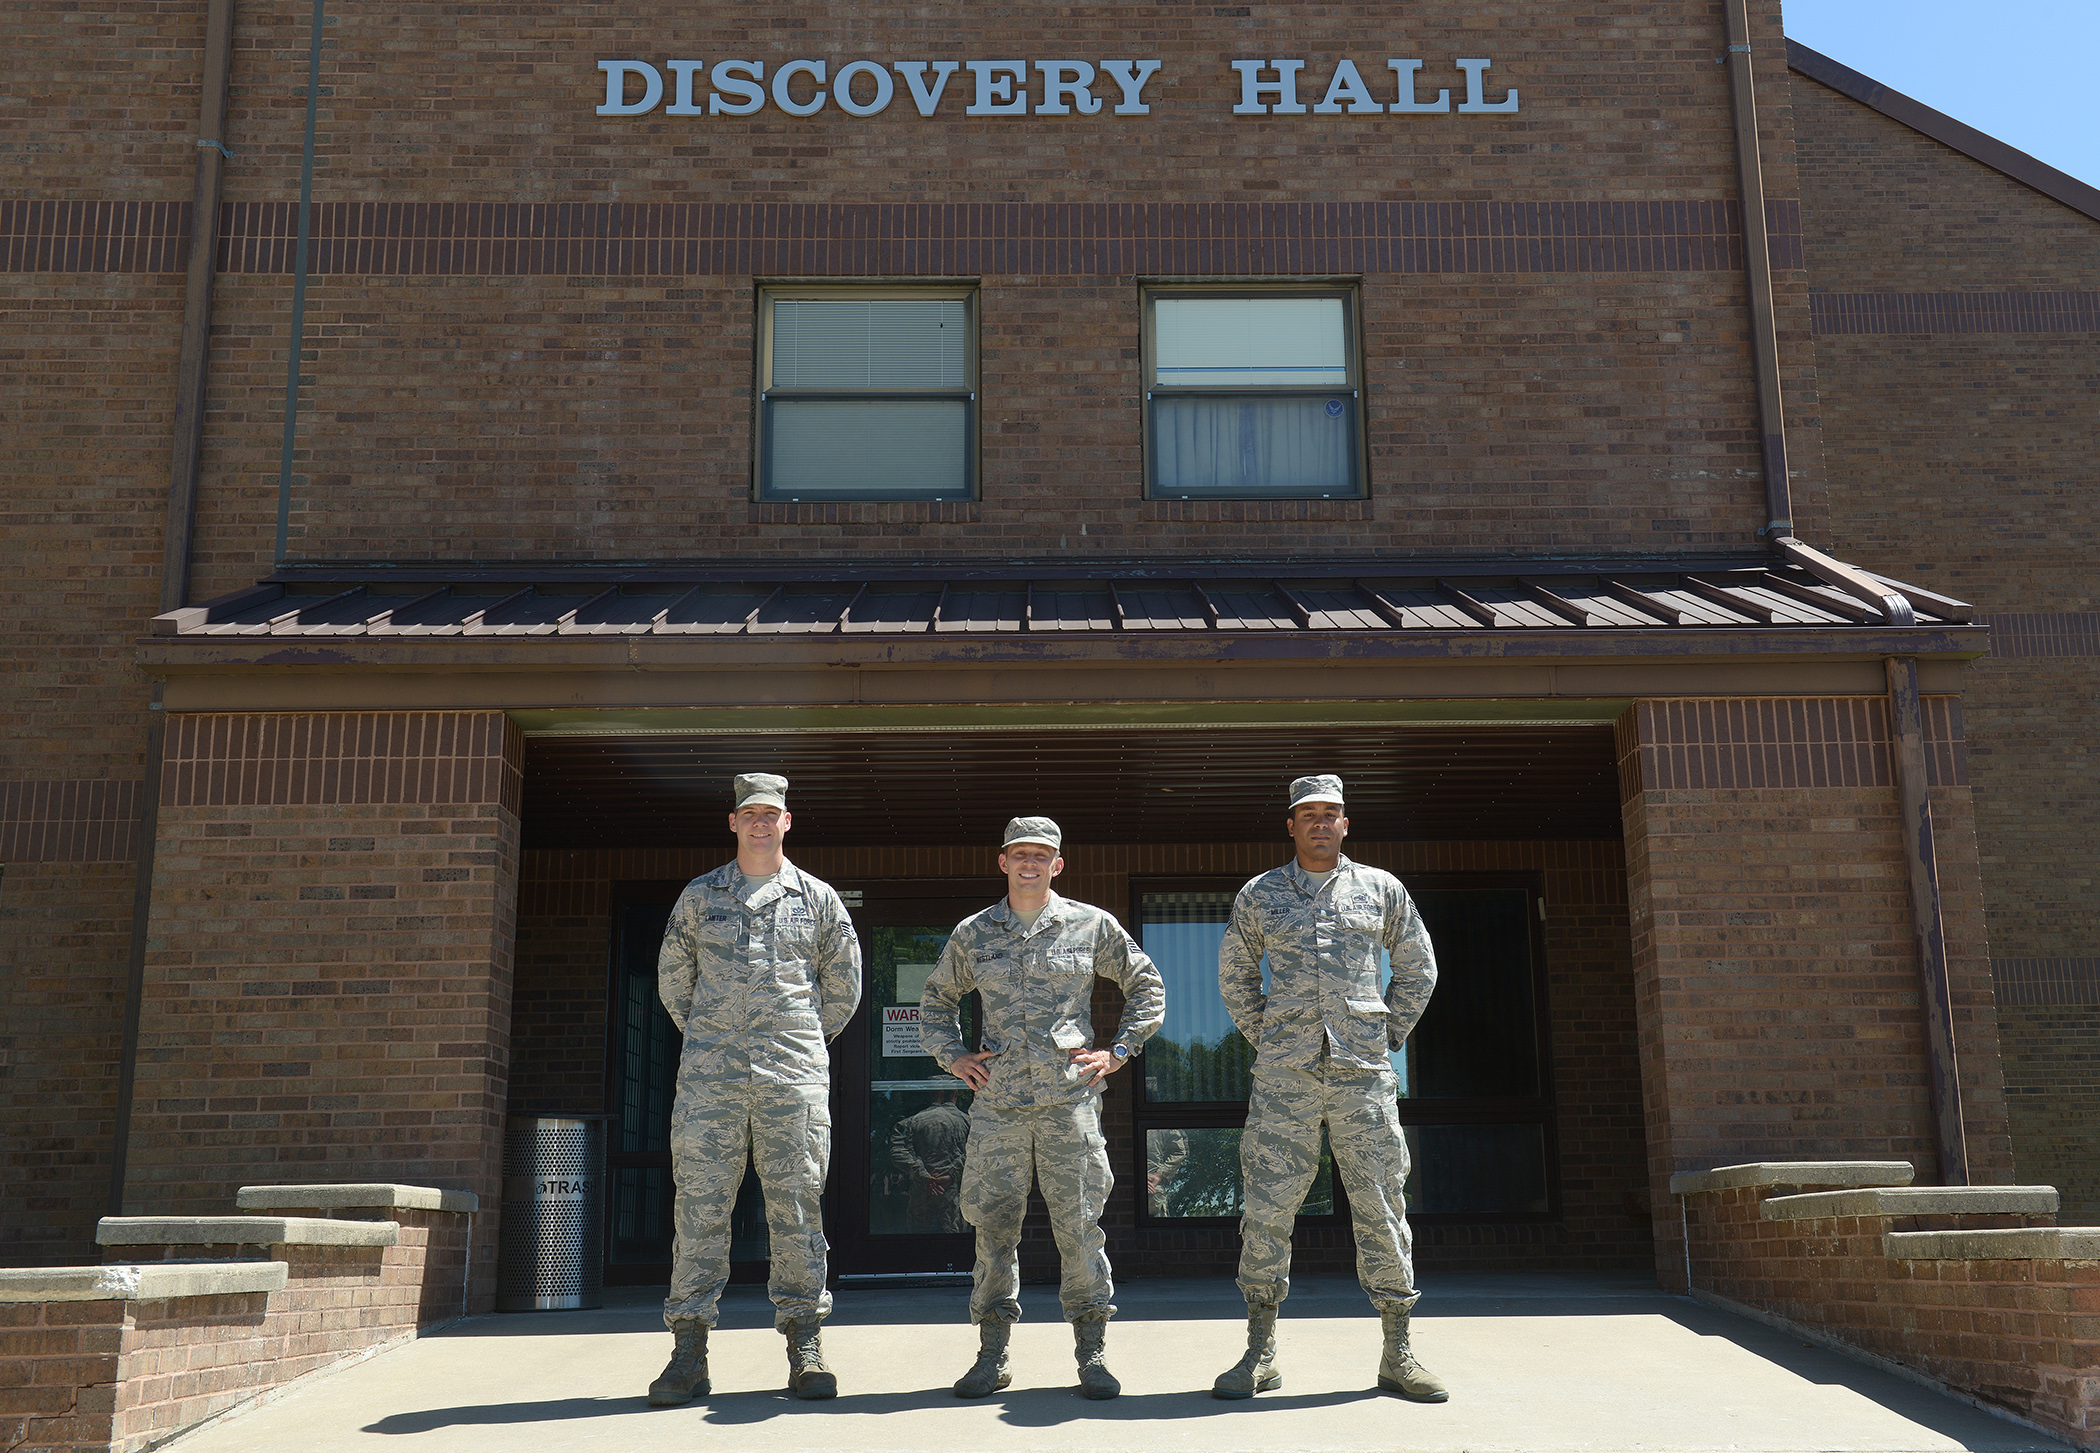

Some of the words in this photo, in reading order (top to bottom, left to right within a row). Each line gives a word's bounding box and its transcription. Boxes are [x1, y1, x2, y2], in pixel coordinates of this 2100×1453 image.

[596, 59, 1161, 117] DISCOVERY
[1231, 58, 1519, 115] HALL
[1270, 907, 1290, 915] MILLER
[800, 918, 816, 926] FORCE
[886, 1009, 922, 1021] WAR
[547, 1180, 597, 1194] TRASH
